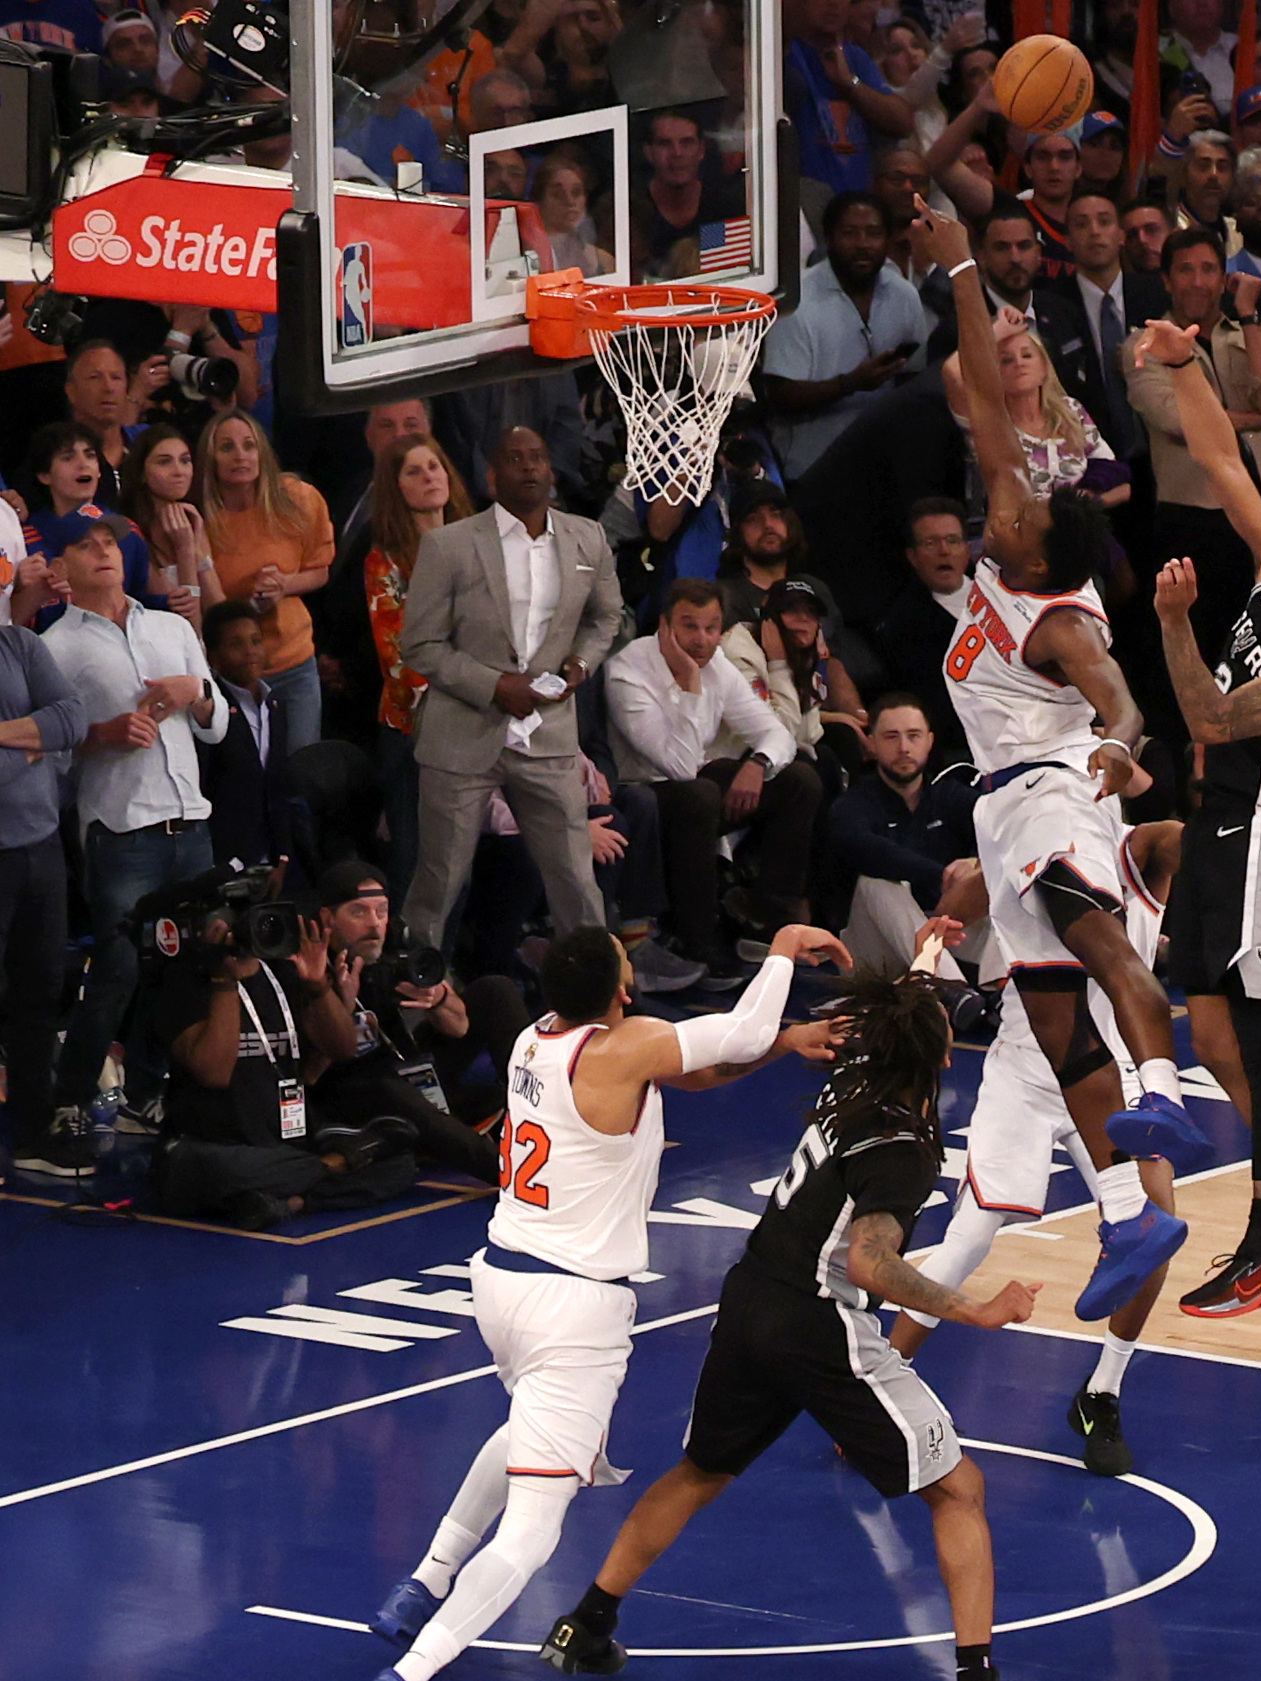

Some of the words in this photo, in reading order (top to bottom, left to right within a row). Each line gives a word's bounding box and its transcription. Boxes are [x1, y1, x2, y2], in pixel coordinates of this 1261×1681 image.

[946, 623, 986, 682] 8
[511, 1065, 544, 1108] TOWNS
[775, 1122, 830, 1210] 5
